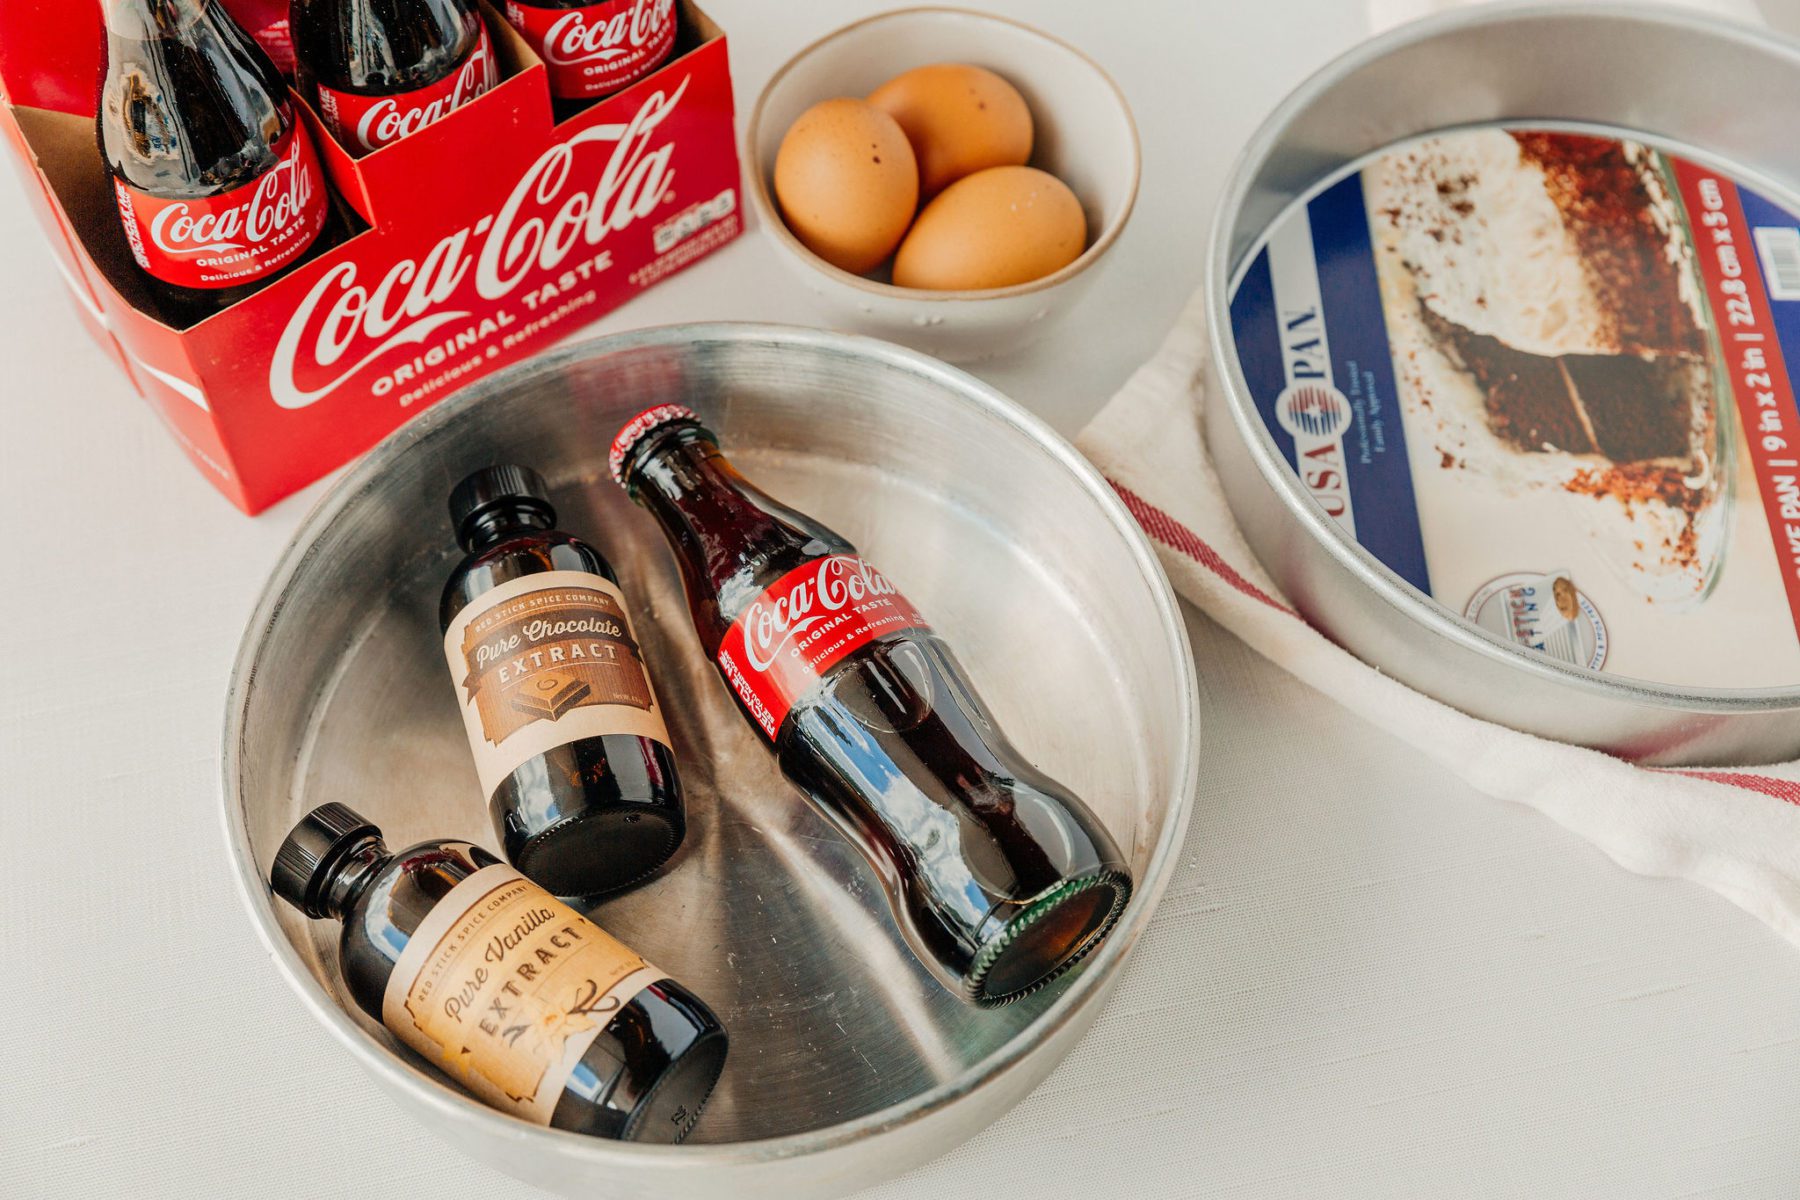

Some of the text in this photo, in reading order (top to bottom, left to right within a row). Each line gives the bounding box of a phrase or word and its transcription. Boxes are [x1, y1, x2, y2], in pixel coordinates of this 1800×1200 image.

[544, 0, 674, 65] Coca-Co
[584, 49, 646, 76] ORIGINAL
[151, 138, 313, 254] Coca-Cola
[1698, 178, 1724, 211] cm
[1701, 211, 1729, 228] 5
[196, 245, 268, 267] ORIGINAL
[270, 214, 305, 246] TASTE
[200, 231, 311, 282] Delicious & Refreshing
[269, 73, 691, 409] Coca-Cola
[1712, 227, 1734, 244] x
[1716, 244, 1743, 279] cm
[371, 250, 614, 397] ORIGINAL TASTE
[1720, 278, 1756, 327] 22.8
[399, 290, 597, 408] Delicious & Refreshing
[1741, 347, 1767, 370] in
[1745, 371, 1773, 389] 2
[1755, 390, 1778, 408] x
[1758, 409, 1784, 433] in
[1761, 435, 1788, 452] 9
[1304, 443, 1346, 518] USA
[1772, 474, 1800, 519] PAN
[475, 593, 610, 633] RED STICK SPICE COMPANY
[744, 555, 898, 672] Coca-Cola
[790, 597, 893, 658] ORIGINAL TASTE
[476, 617, 622, 670] Pure Chocolate
[498, 643, 619, 684] EXTRACT
[802, 639, 846, 674] Delicious
[846, 633, 855, 642] &
[855, 614, 905, 636] Refreshing
[732, 673, 775, 737] RECYCLE
[752, 693, 764, 711] YOU
[418, 885, 528, 1002] RED STICK SPICE COMPANY
[444, 905, 556, 1024] Pure Vanilla
[478, 924, 584, 1039] EXTRACT
